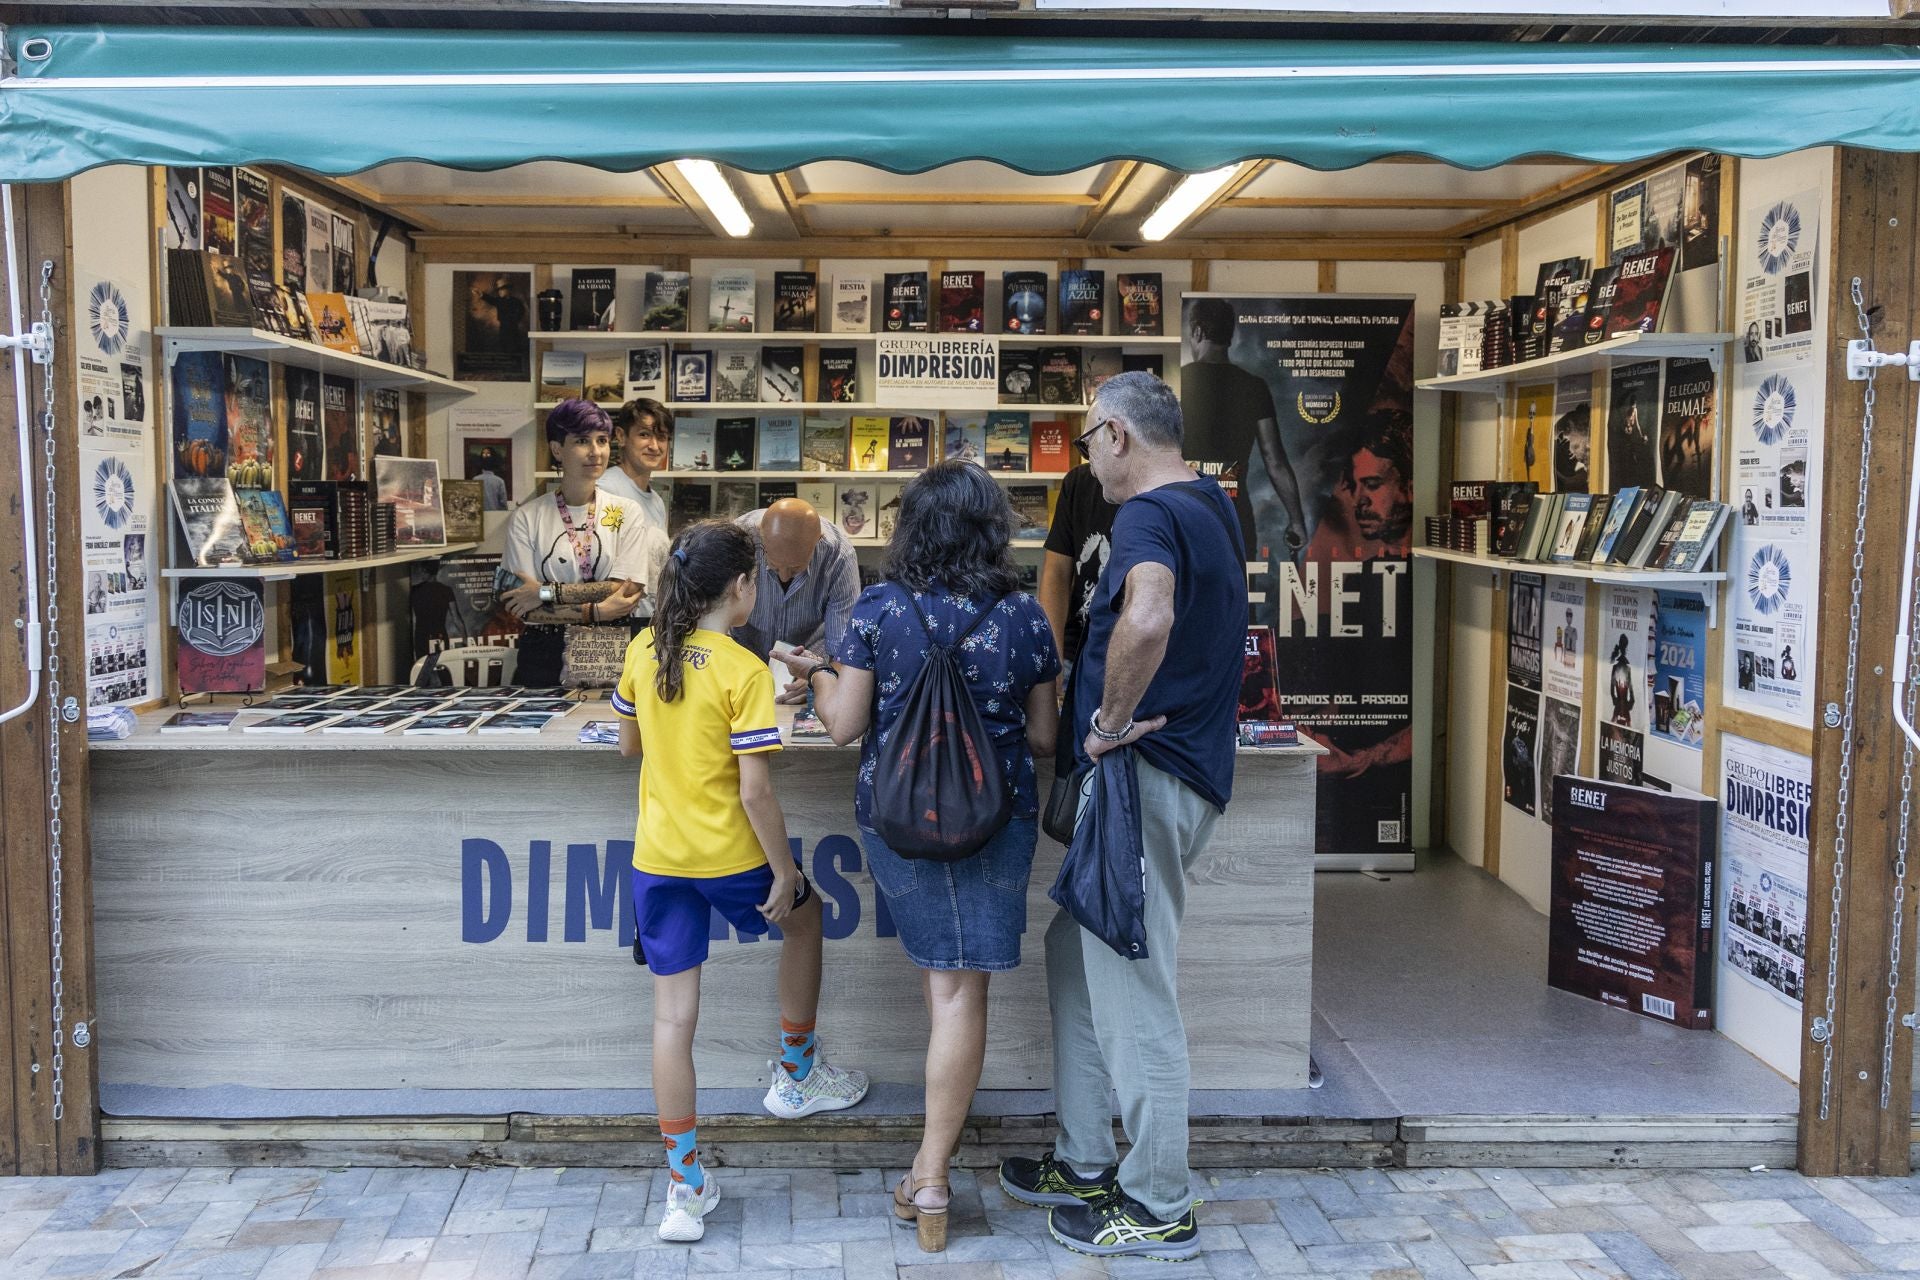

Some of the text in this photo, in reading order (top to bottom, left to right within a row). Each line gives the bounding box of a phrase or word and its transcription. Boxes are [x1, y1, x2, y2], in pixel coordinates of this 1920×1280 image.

[1622, 256, 1659, 275] BENET
[943, 275, 973, 285] BENET
[791, 291, 810, 299] MAL
[892, 286, 920, 296] BENET
[1068, 290, 1098, 300] AZUL
[1128, 292, 1155, 301] AZUL
[1787, 300, 1808, 316] BENET
[1292, 315, 1306, 324] QUE
[1334, 316, 1361, 324] CAMBIA
[880, 339, 995, 354] GRUPO LIBRERÍA
[1320, 350, 1330, 358] QUE
[879, 354, 995, 379] DIMPRESION
[1309, 369, 1345, 377] DESAPARECIERA
[324, 385, 345, 406] BENET
[1669, 381, 1711, 397] EL LEGADO
[295, 398, 314, 420] BENET
[1305, 400, 1328, 408] NÚMERO
[1668, 397, 1706, 417] DEL MAL
[1203, 462, 1223, 475] HOY
[1453, 486, 1484, 498] BENET
[294, 512, 316, 523] BENET
[1246, 562, 1407, 638] ENET
[1613, 594, 1638, 606] TIEMPOS
[1612, 606, 1638, 619] DE AMOR
[1615, 620, 1638, 631] MUERTE
[685, 644, 712, 653] ANGELES
[1660, 644, 1695, 670] 2024
[1281, 695, 1408, 704] EMONIOS DEL PASADO
[1600, 736, 1640, 761] LA MEMORIA
[1606, 760, 1633, 780] JUSTOS
[1726, 759, 1811, 803] GRUPO LIBRER
[1570, 787, 1607, 807] BENET
[1726, 777, 1811, 842] DIMPRESI
[1701, 908, 1711, 929] BENET
